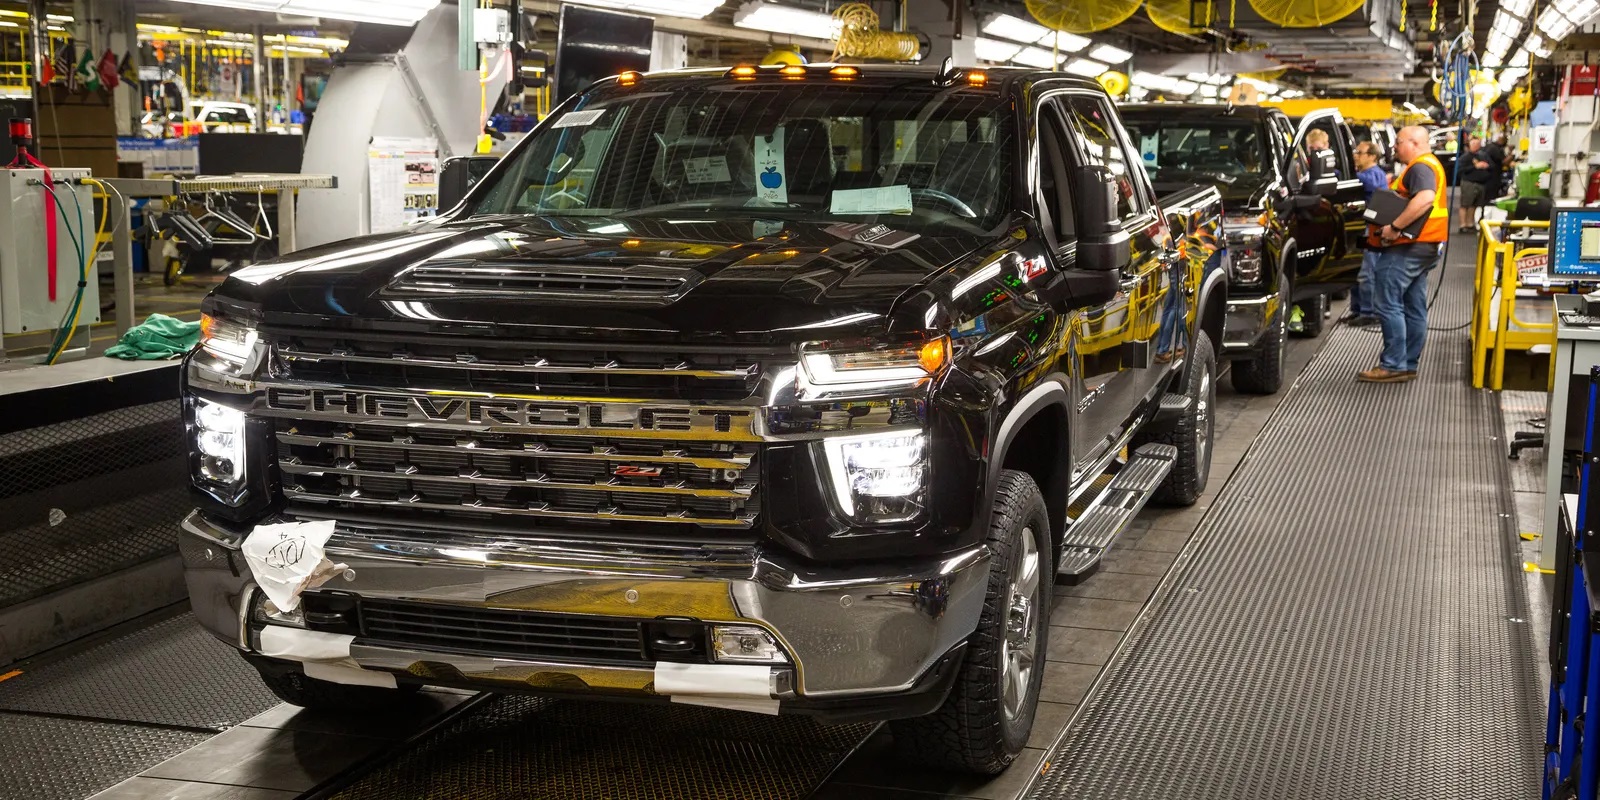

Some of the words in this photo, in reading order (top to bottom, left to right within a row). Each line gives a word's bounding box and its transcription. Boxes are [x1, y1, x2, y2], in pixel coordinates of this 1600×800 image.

[1518, 256, 1548, 268] NOTI
[265, 387, 750, 432] CHEVROLET
[614, 465, 663, 477] Z71
